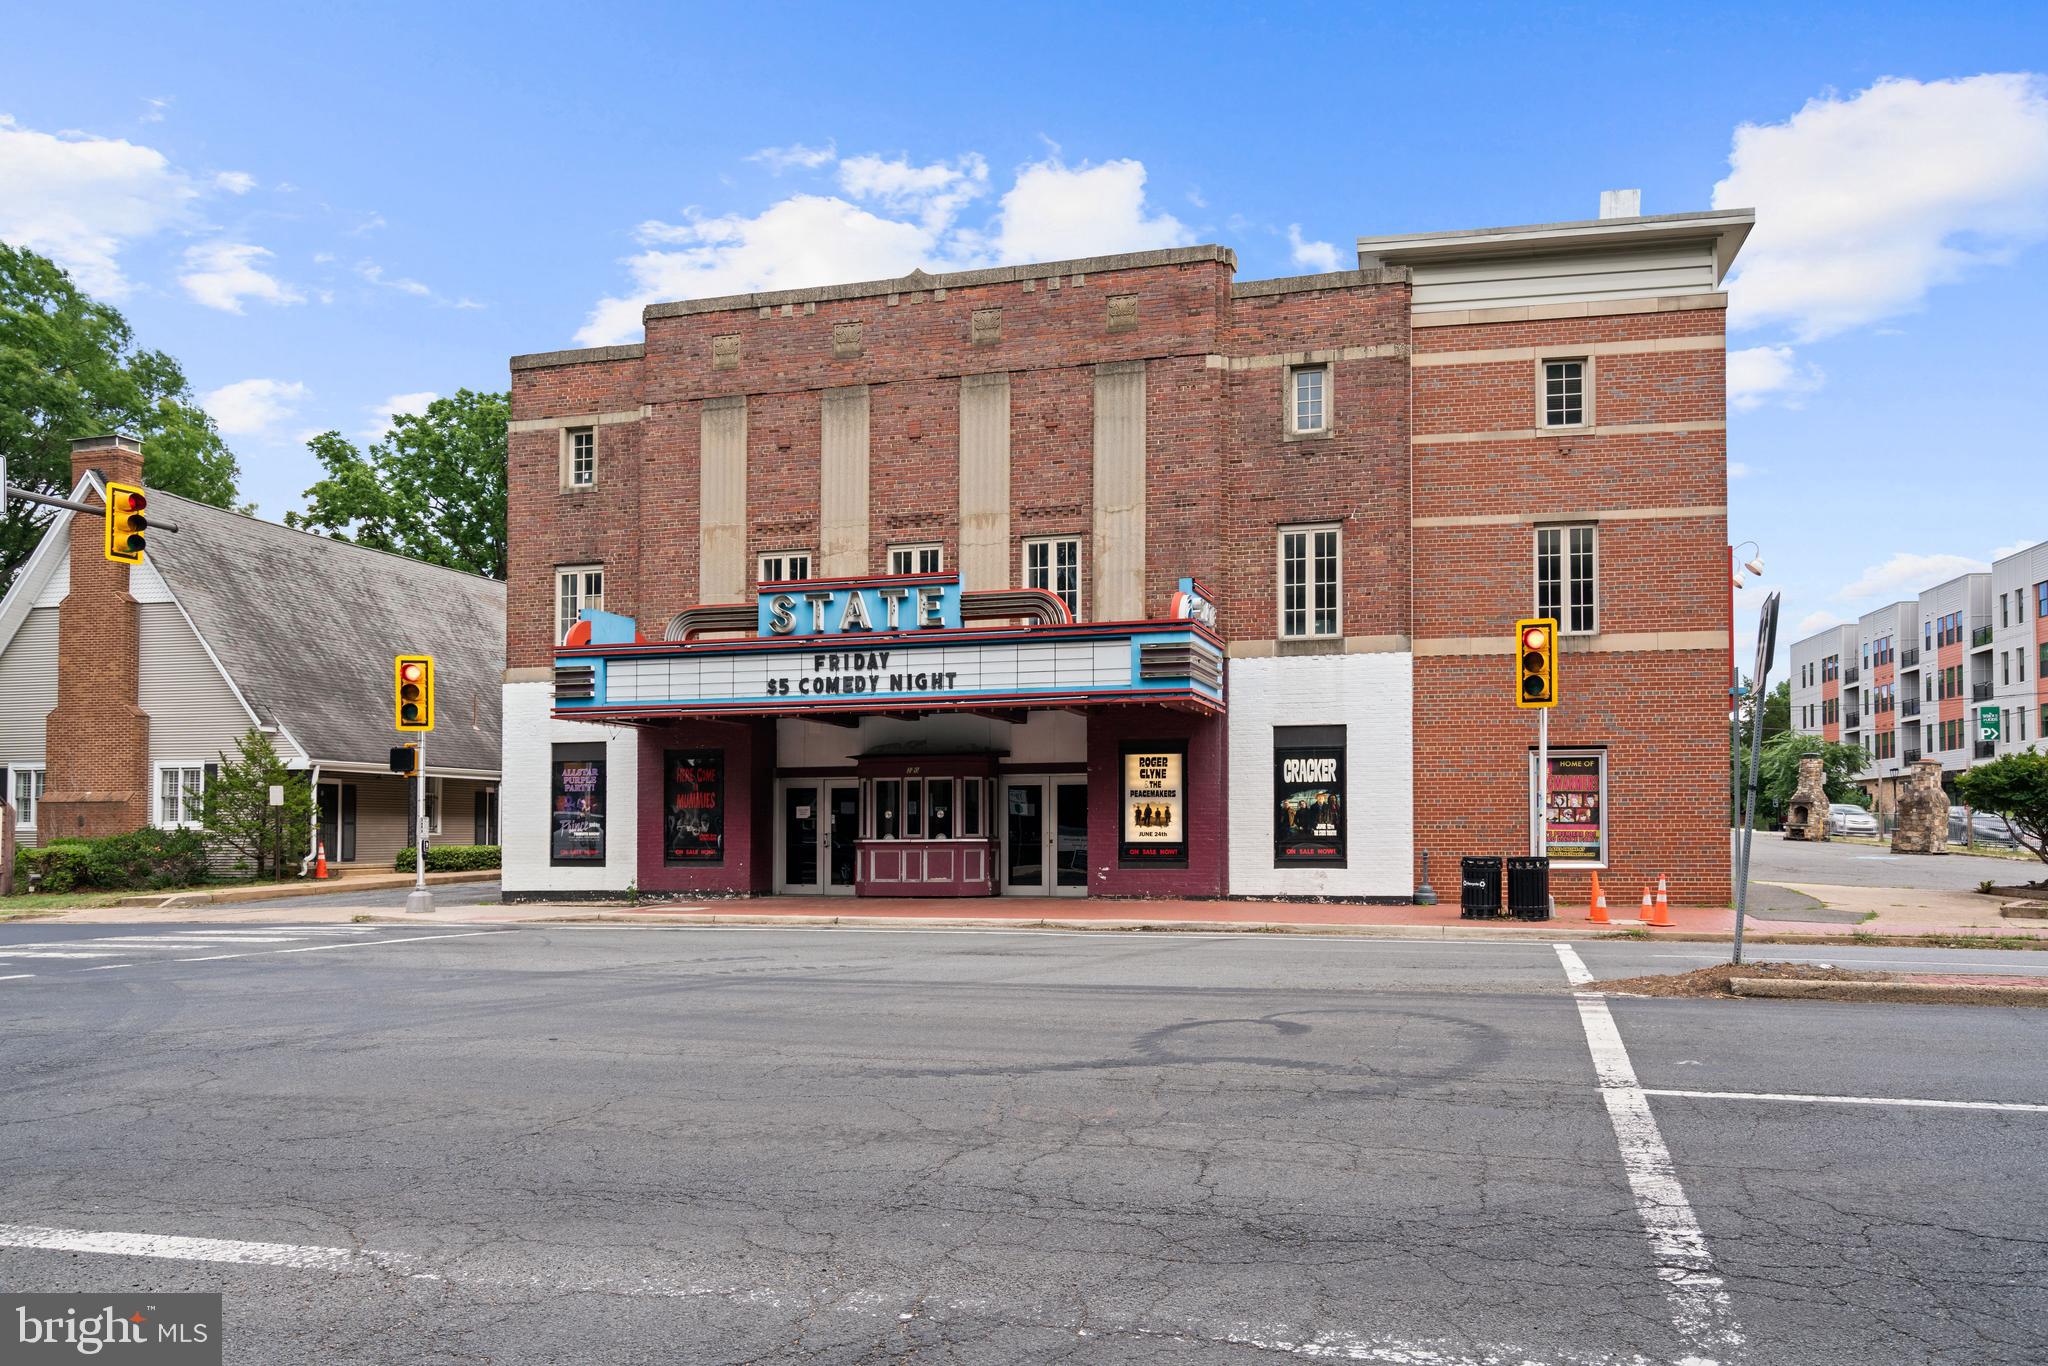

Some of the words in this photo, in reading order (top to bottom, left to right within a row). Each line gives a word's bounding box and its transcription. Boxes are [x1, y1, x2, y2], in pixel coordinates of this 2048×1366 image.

[769, 587, 945, 634] STATE
[814, 652, 890, 672] FRIDAY
[767, 678, 789, 695] $5
[799, 674, 880, 694] COMEDY
[890, 672, 957, 691] NIGHT
[1981, 728, 1991, 740] P
[1139, 757, 1168, 767] ROGER
[562, 768, 599, 777] ALLSTAR
[1139, 769, 1167, 779] CLYNE
[1283, 758, 1337, 783] CRACKER
[565, 784, 595, 792] PARTY!
[1129, 790, 1177, 798] PEACEMAKERS
[676, 792, 716, 809] MUMMIES
[560, 820, 589, 838] Prince
